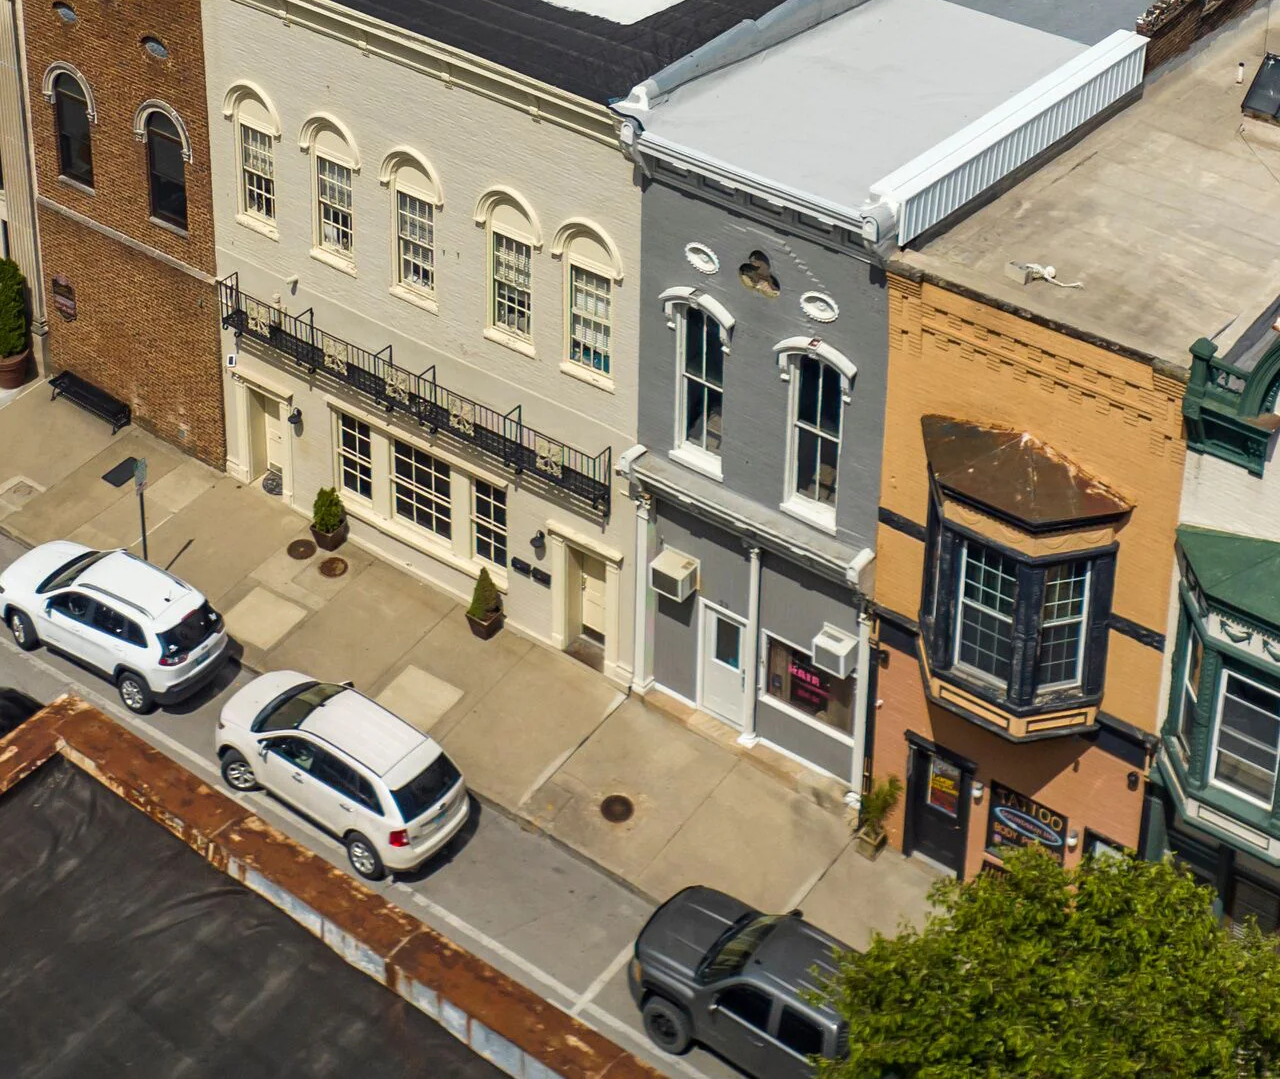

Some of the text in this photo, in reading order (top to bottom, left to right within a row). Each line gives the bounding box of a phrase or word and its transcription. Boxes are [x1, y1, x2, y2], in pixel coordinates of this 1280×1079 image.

[787, 664, 820, 687] HAIR
[996, 788, 1063, 831] TATTOO
[994, 821, 1019, 839] BODY
